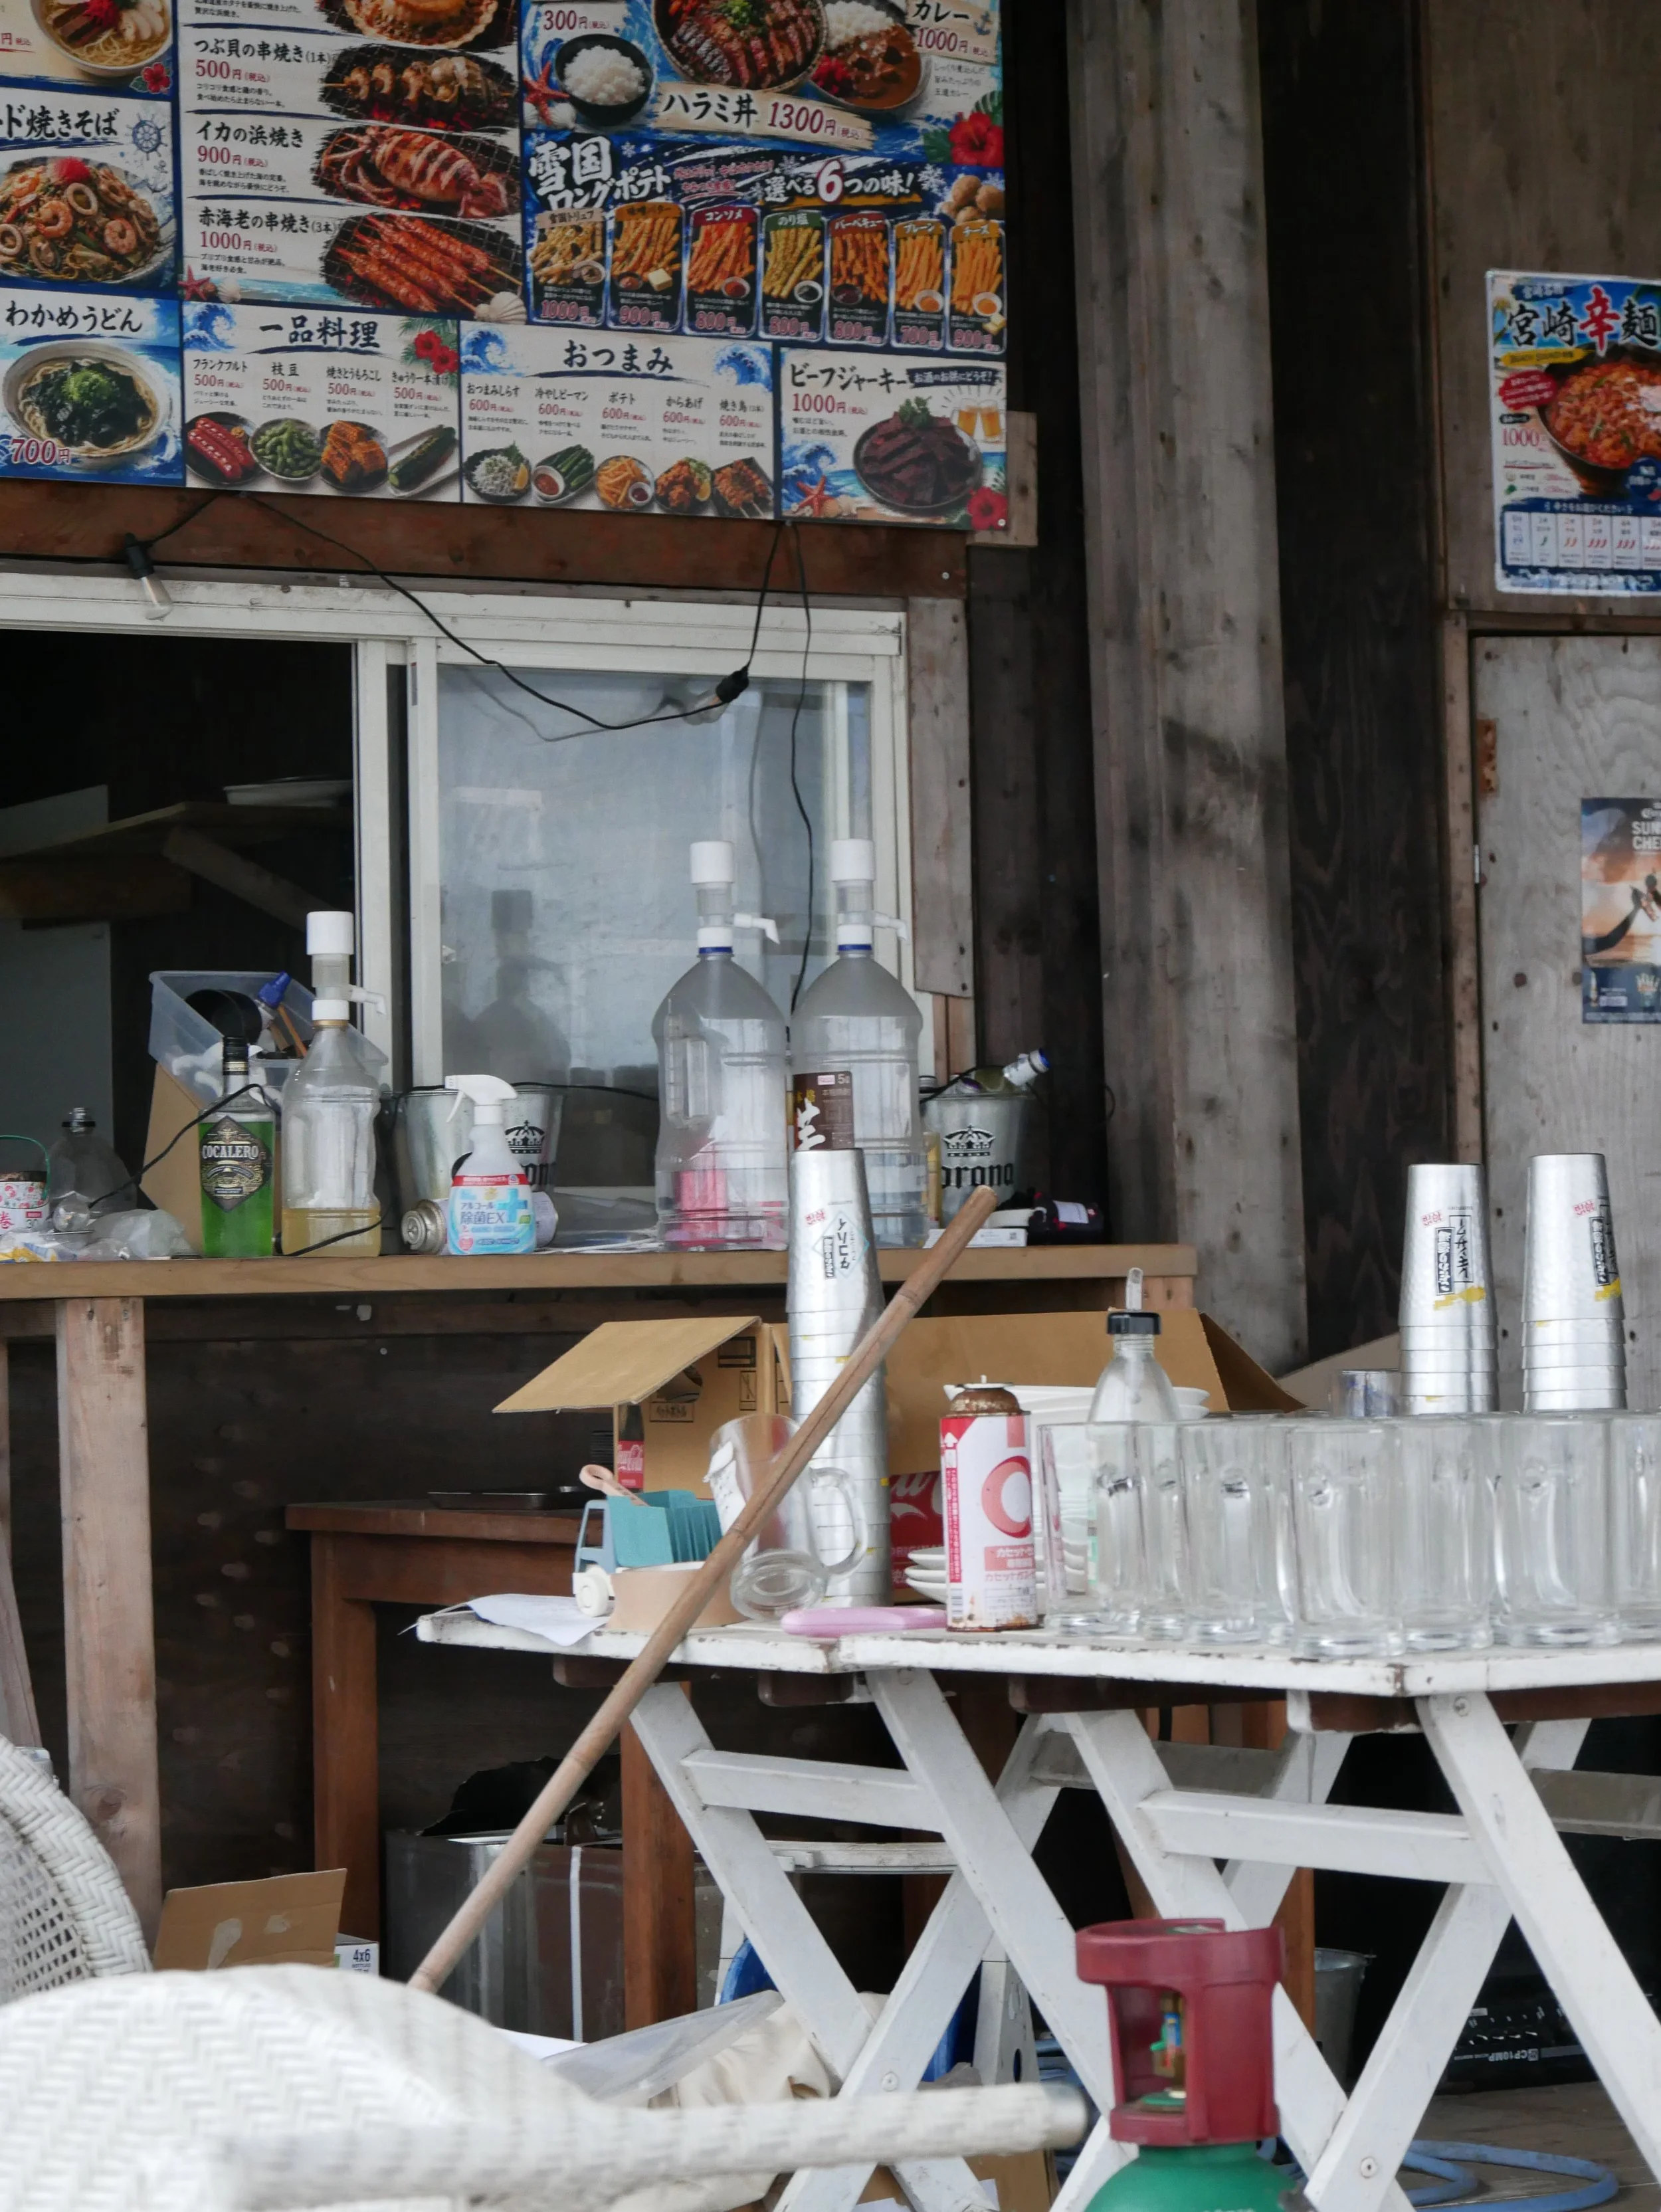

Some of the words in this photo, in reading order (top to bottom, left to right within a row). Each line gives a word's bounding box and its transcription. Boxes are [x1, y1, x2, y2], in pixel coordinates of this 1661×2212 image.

[913, 3, 969, 23] カレー
[663, 93, 758, 128] ハラミ丼
[0, 104, 119, 138] ド焼きそば
[196, 120, 303, 148] イカの浜焼き
[529, 136, 612, 195] 雪国
[705, 210, 744, 224] コンソメ
[778, 213, 809, 226] のり塩
[962, 226, 990, 237] チーズ
[5, 300, 143, 332] わかめうどん
[1508, 287, 1659, 352] 宮崎辛麺
[260, 315, 381, 348] 一品料理
[564, 340, 673, 373] おつまみ
[193, 359, 248, 372] フランクフルト
[271, 362, 299, 377] 枝豆
[326, 366, 381, 381] 焼きとうもろこし
[790, 363, 906, 394] ビーフジャーキー
[466, 383, 520, 397] おつまみしらす
[535, 387, 589, 401] 冷やしピーマン
[609, 391, 636, 405] ポテト
[665, 395, 704, 409] からあげ
[11, 439, 71, 464] 700円
[202, 1144, 259, 1159] COCALERO
[461, 1201, 496, 1210] アルコール
[460, 1211, 506, 1225] 除菌EX
[1454, 1217, 1470, 1278] レモンサワー
[353, 1948, 371, 1963] 4x6
[1488, 2049, 1528, 2062] CP10MP
